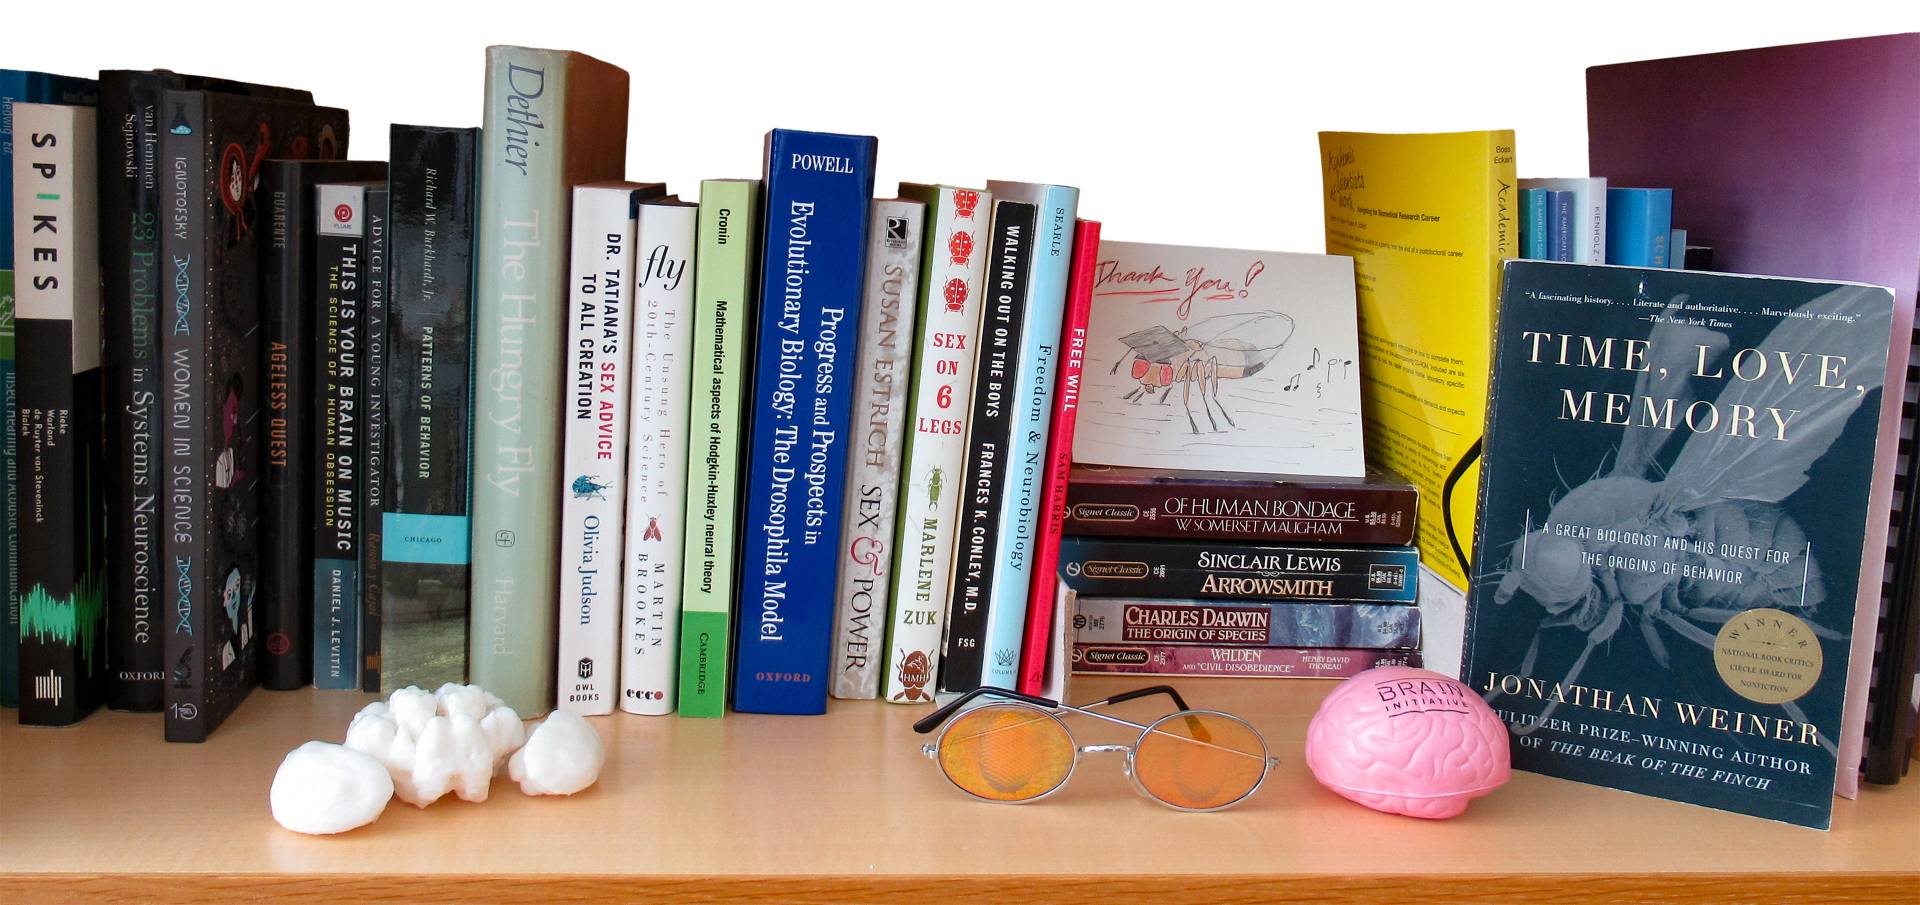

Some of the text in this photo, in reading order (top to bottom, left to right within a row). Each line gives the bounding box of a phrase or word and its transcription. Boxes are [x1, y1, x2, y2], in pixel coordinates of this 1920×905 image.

[504, 62, 545, 176] Dethier
[125, 113, 135, 179] Sejnowski
[145, 105, 156, 189] van Hemmen
[791, 153, 854, 174] POWELL
[31, 133, 60, 291] SPIKES
[175, 157, 188, 240] IGNOTOFSKY
[1497, 179, 1511, 252] Academic
[273, 191, 286, 249] GUARENTE
[718, 207, 731, 245] Cronin
[1051, 207, 1064, 257] SEARLE
[1592, 206, 1601, 255] KIENHOLZ
[330, 265, 338, 290] THE
[341, 244, 356, 291] THIS
[639, 244, 686, 291] fly
[1096, 260, 1177, 288] Thank
[329, 297, 338, 353] SCIENCE
[341, 300, 355, 319] IS
[879, 264, 903, 348] SUSAN
[986, 226, 1021, 418] WALKING OUT ON THE BOYS
[1539, 291, 1582, 304] fascinating
[1633, 298, 1665, 308] Literate
[1667, 300, 1683, 310] and
[1761, 307, 1815, 320] Marvelously
[1667, 315, 1685, 325] New
[1687, 317, 1705, 326] York
[1708, 318, 1733, 328] Times
[340, 323, 355, 381] YOUR
[487, 209, 540, 497] The Hungry Fly
[933, 332, 967, 349] SEX
[328, 361, 336, 376] OF
[936, 359, 958, 376] ON
[1522, 331, 1866, 397] TIME, LOVE,
[339, 385, 354, 434] BRAIN
[418, 326, 434, 479] PATTERNS OF BEHAVIOR
[866, 358, 895, 468] ESTRICH
[937, 385, 952, 409] 6
[1556, 388, 1801, 442] MEMORY
[22, 408, 30, 437] Bialek
[47, 409, 56, 447] Worland
[59, 408, 68, 435] Rieke
[126, 212, 156, 644] 23 Problems in Systems Neuroscience
[326, 398, 336, 447] HUMAN
[760, 200, 815, 641] Evolutionary Biology: The Drosophila Model
[803, 307, 845, 545] Progress and Prospects in
[918, 417, 962, 436] LEGS
[173, 348, 192, 544] WOMEN IN SCIENCE
[1010, 344, 1052, 572] Freedom & Neurobiology
[338, 454, 353, 481] ON
[326, 453, 335, 527] OBSESSION
[1050, 452, 1069, 535] SAM HARRIS
[1164, 498, 1356, 519] OF HUMAN BONDAGE
[338, 489, 352, 551] MUSIC
[1078, 508, 1135, 518] Signet Classic
[404, 536, 442, 544] CHICAGO
[915, 517, 938, 602] MARLENE
[1542, 523, 1790, 564] A GREAT BIOLOGIST AND HIS QUEST FOR
[578, 515, 600, 625] Olivia Judson
[1197, 551, 1341, 572] SINCLAIR LEWIS
[1580, 551, 1743, 585] THE ORIGINS OF BEHAVIOR
[634, 552, 649, 656] BROOKES
[651, 562, 665, 647] MARTIN
[1200, 573, 1334, 597] ARROWSMITH
[493, 579, 513, 656] Harvard
[903, 610, 937, 625] ZUK
[1125, 606, 1200, 627] CHARLES
[1202, 609, 1269, 628] DARWIN
[1127, 628, 1266, 641] THE ORIGIN OF SPECIES
[1729, 617, 1808, 648] WINNER
[958, 637, 976, 648] FSG
[1211, 648, 1262, 662] WALDEN
[1302, 655, 1350, 665] HENRY DAVID
[1721, 647, 1815, 668] NATIONAL BOOK CRITICS
[697, 632, 709, 695] CAMBRIDGE
[756, 672, 811, 683] OXFORD
[903, 672, 928, 683] HMH
[1308, 662, 1342, 671] THOREAU
[1730, 664, 1802, 681] CIRCLE AWARD FOR
[570, 694, 599, 702] BOOKS
[1377, 680, 1465, 702] BRAIN
[1386, 698, 1469, 712] INITIATIVE
[1740, 679, 1789, 693] NONFICTION
[1483, 670, 1820, 747] JONATHAN WEINER
[1519, 735, 1772, 791] OF THE BEAK OF THE FINCH
